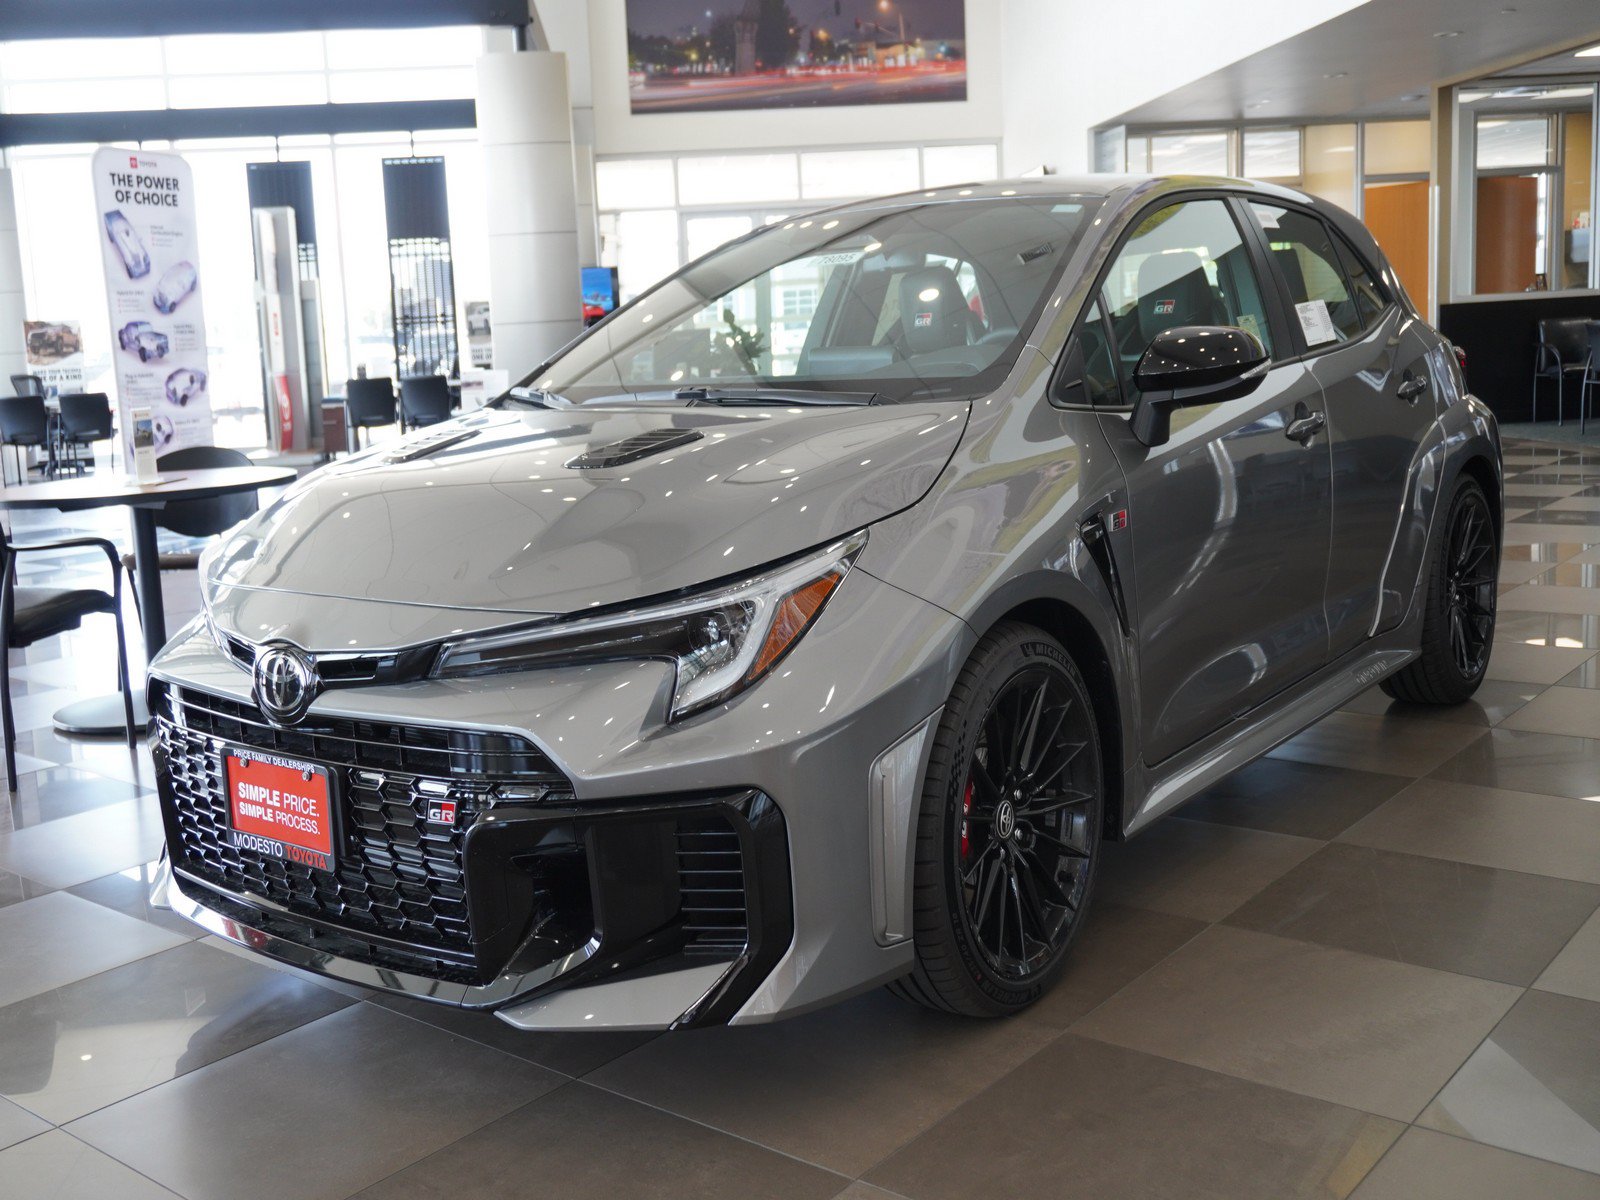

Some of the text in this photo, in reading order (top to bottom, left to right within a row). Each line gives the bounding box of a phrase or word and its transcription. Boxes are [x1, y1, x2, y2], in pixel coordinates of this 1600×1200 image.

[110, 172, 180, 191] THE POWER
[115, 190, 178, 207] OF CHOICE
[1035, 643, 1076, 677] MICHELIN
[233, 749, 315, 773] PRICE FAMILY DEALERSHIPS
[238, 782, 320, 817] SIMPLE PRICE.
[239, 802, 321, 835] SIMPLE PROCESS.
[430, 809, 454, 822] GR
[233, 832, 328, 870] MODESTO TOYOTA
